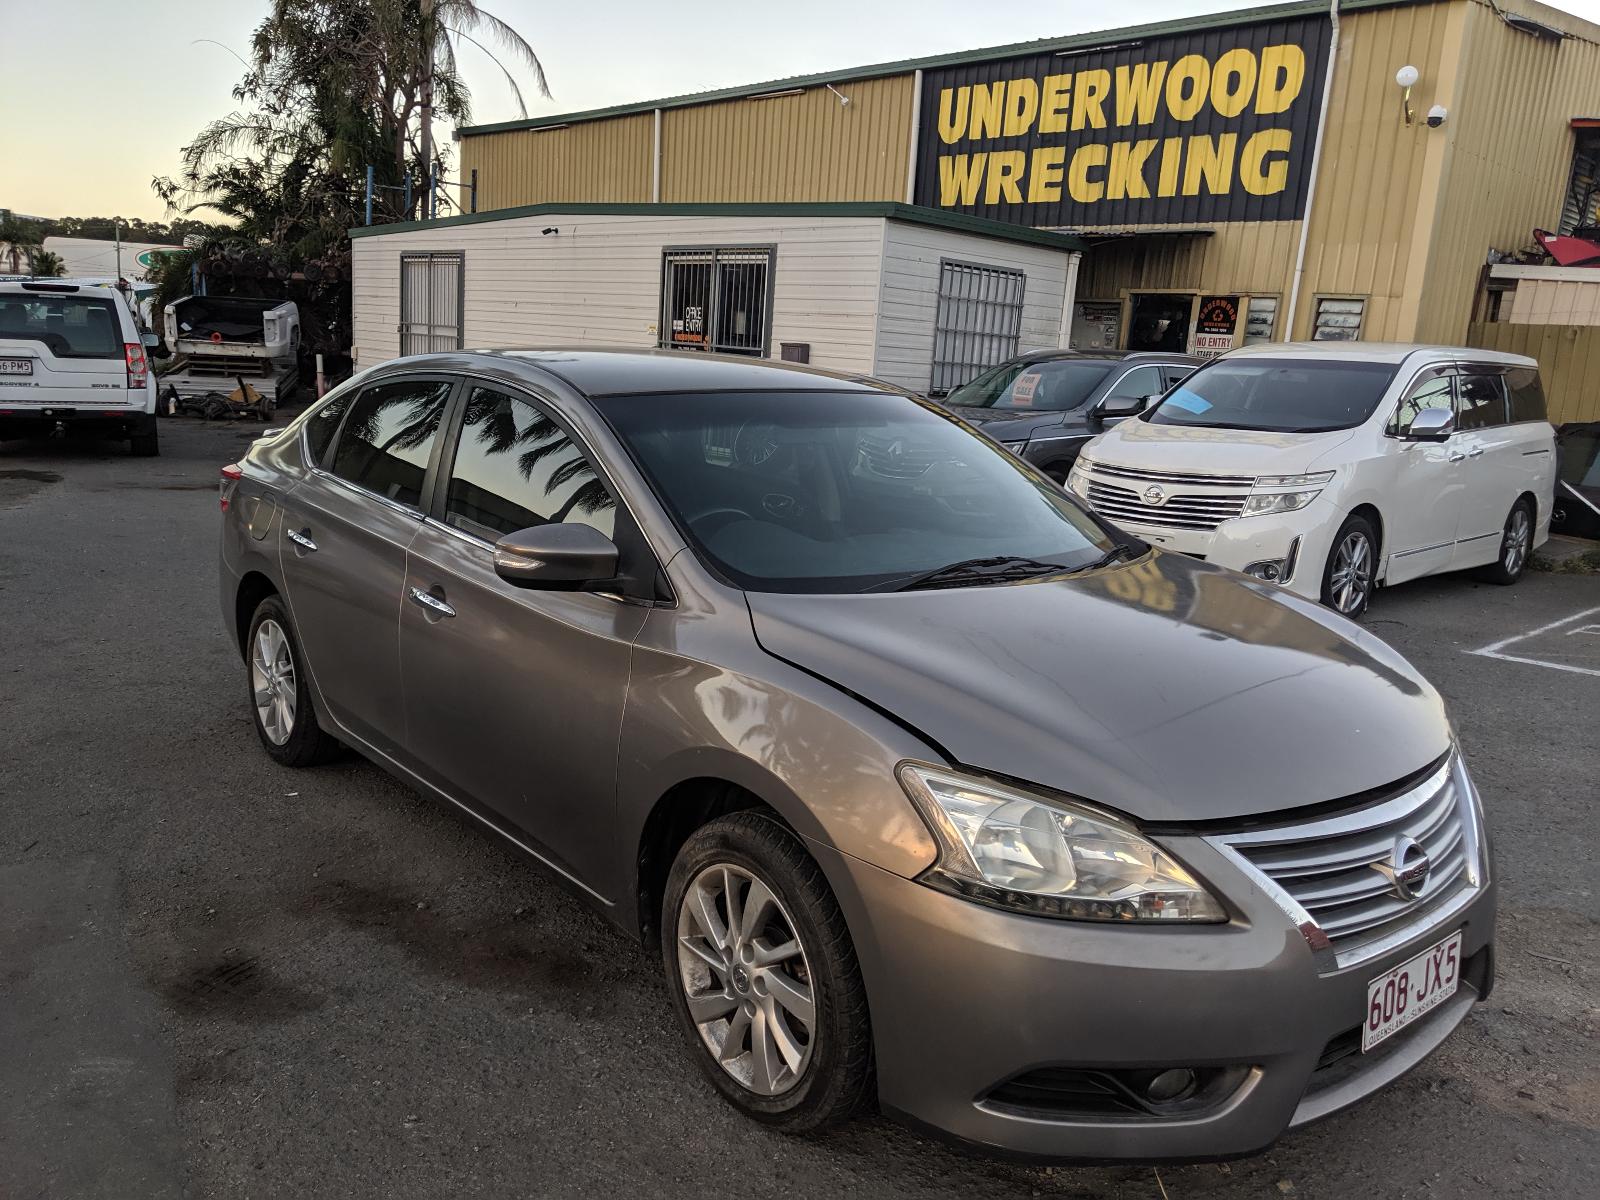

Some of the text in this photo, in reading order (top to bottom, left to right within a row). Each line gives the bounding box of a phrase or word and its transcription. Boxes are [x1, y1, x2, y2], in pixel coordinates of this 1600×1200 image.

[938, 44, 1305, 145] UNDERWOOD
[938, 128, 1292, 207] WRECKING
[686, 306, 702, 319] OFFICE
[1200, 300, 1236, 320] UNDERWOOD
[686, 319, 703, 332] ENTRY
[1196, 337, 1231, 347] NO ENTRY
[1022, 376, 1036, 384] FOR
[1016, 386, 1032, 395] SALE
[1368, 1015, 1406, 1045] QUEENSLAND
[1411, 993, 1439, 1016] SUNSHINE
